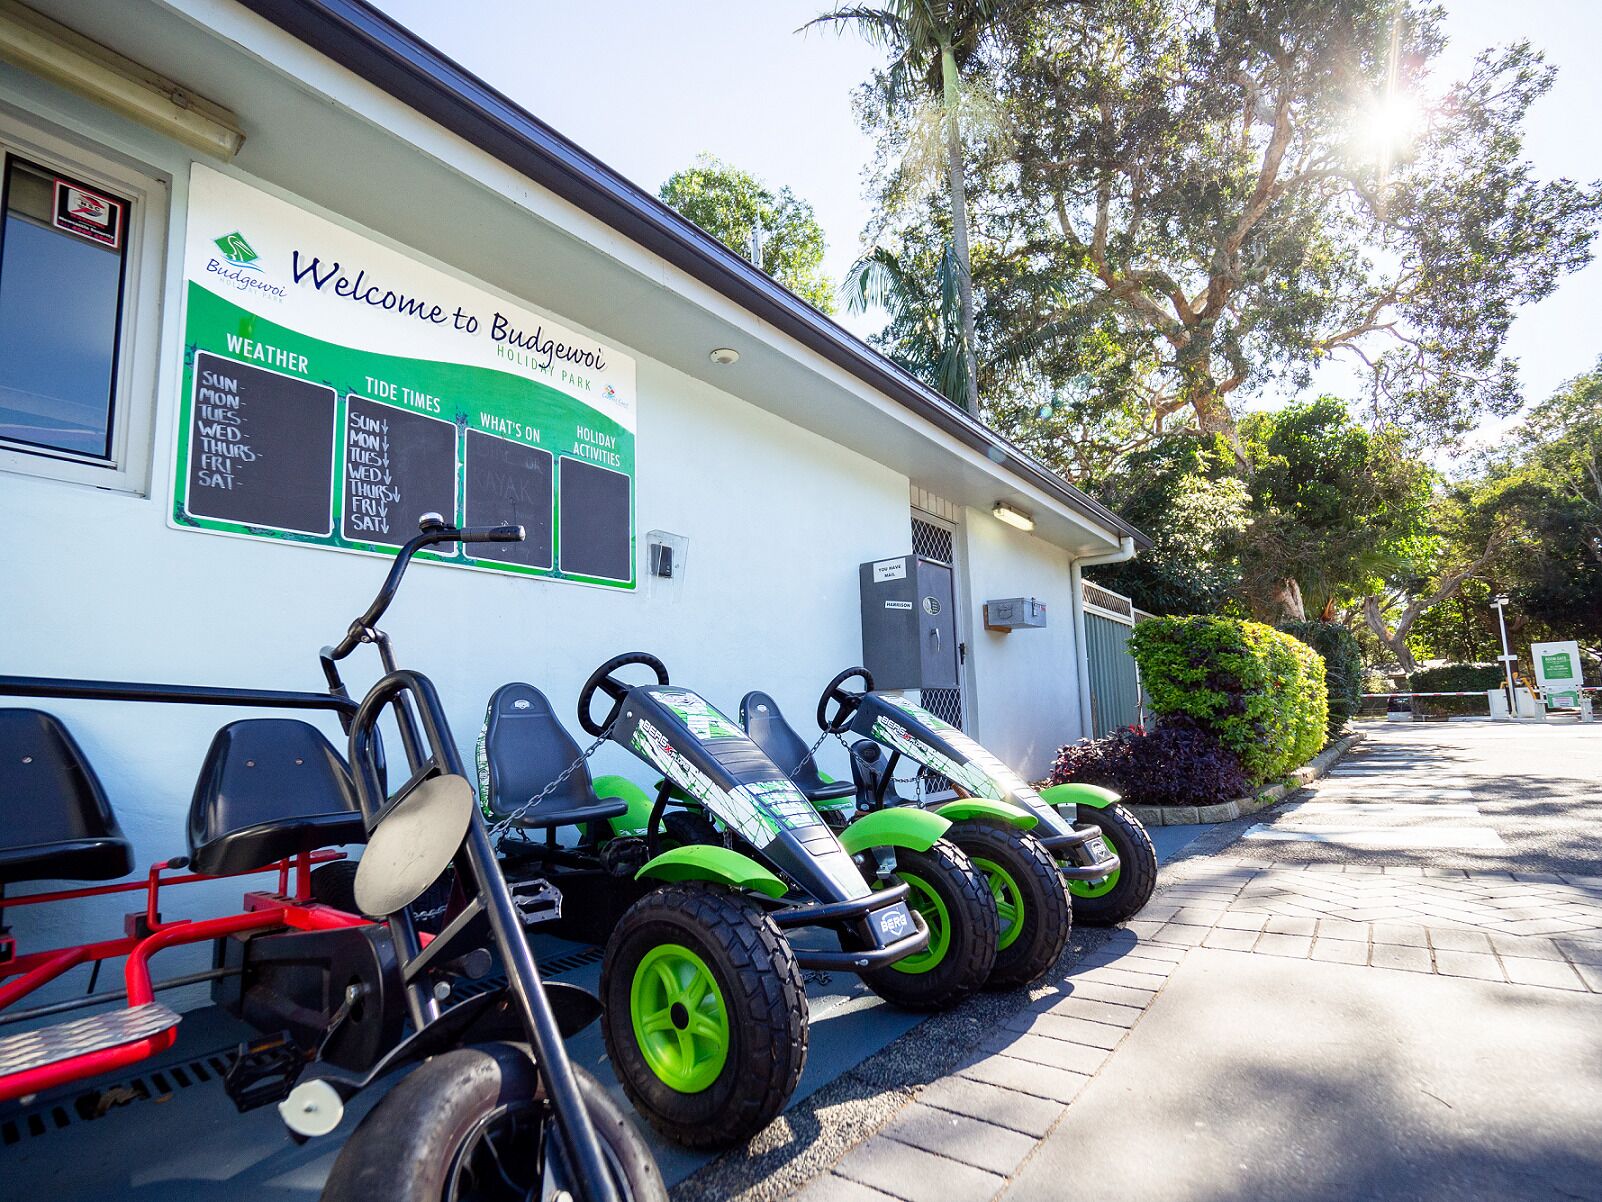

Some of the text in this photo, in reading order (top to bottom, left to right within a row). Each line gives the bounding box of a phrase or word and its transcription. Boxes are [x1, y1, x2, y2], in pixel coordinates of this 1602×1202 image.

[206, 259, 287, 297] Budgewoi
[293, 250, 606, 370] Welcome to Budgewoi
[226, 332, 308, 374] WEATHER
[497, 344, 591, 391] HOLIDAY PARK
[365, 376, 441, 413] TIDE TIMES
[350, 411, 380, 433] SUN
[480, 411, 541, 444] WHAT'S ON
[350, 429, 380, 451] MON
[577, 425, 616, 449] HOLIDAY
[349, 446, 383, 467] TUES
[572, 441, 621, 467] ACTIVITIES
[348, 462, 382, 482] WED
[348, 478, 393, 501] THURS
[352, 496, 377, 516] FRI
[351, 513, 383, 532] SAT
[881, 913, 908, 933] BERG
